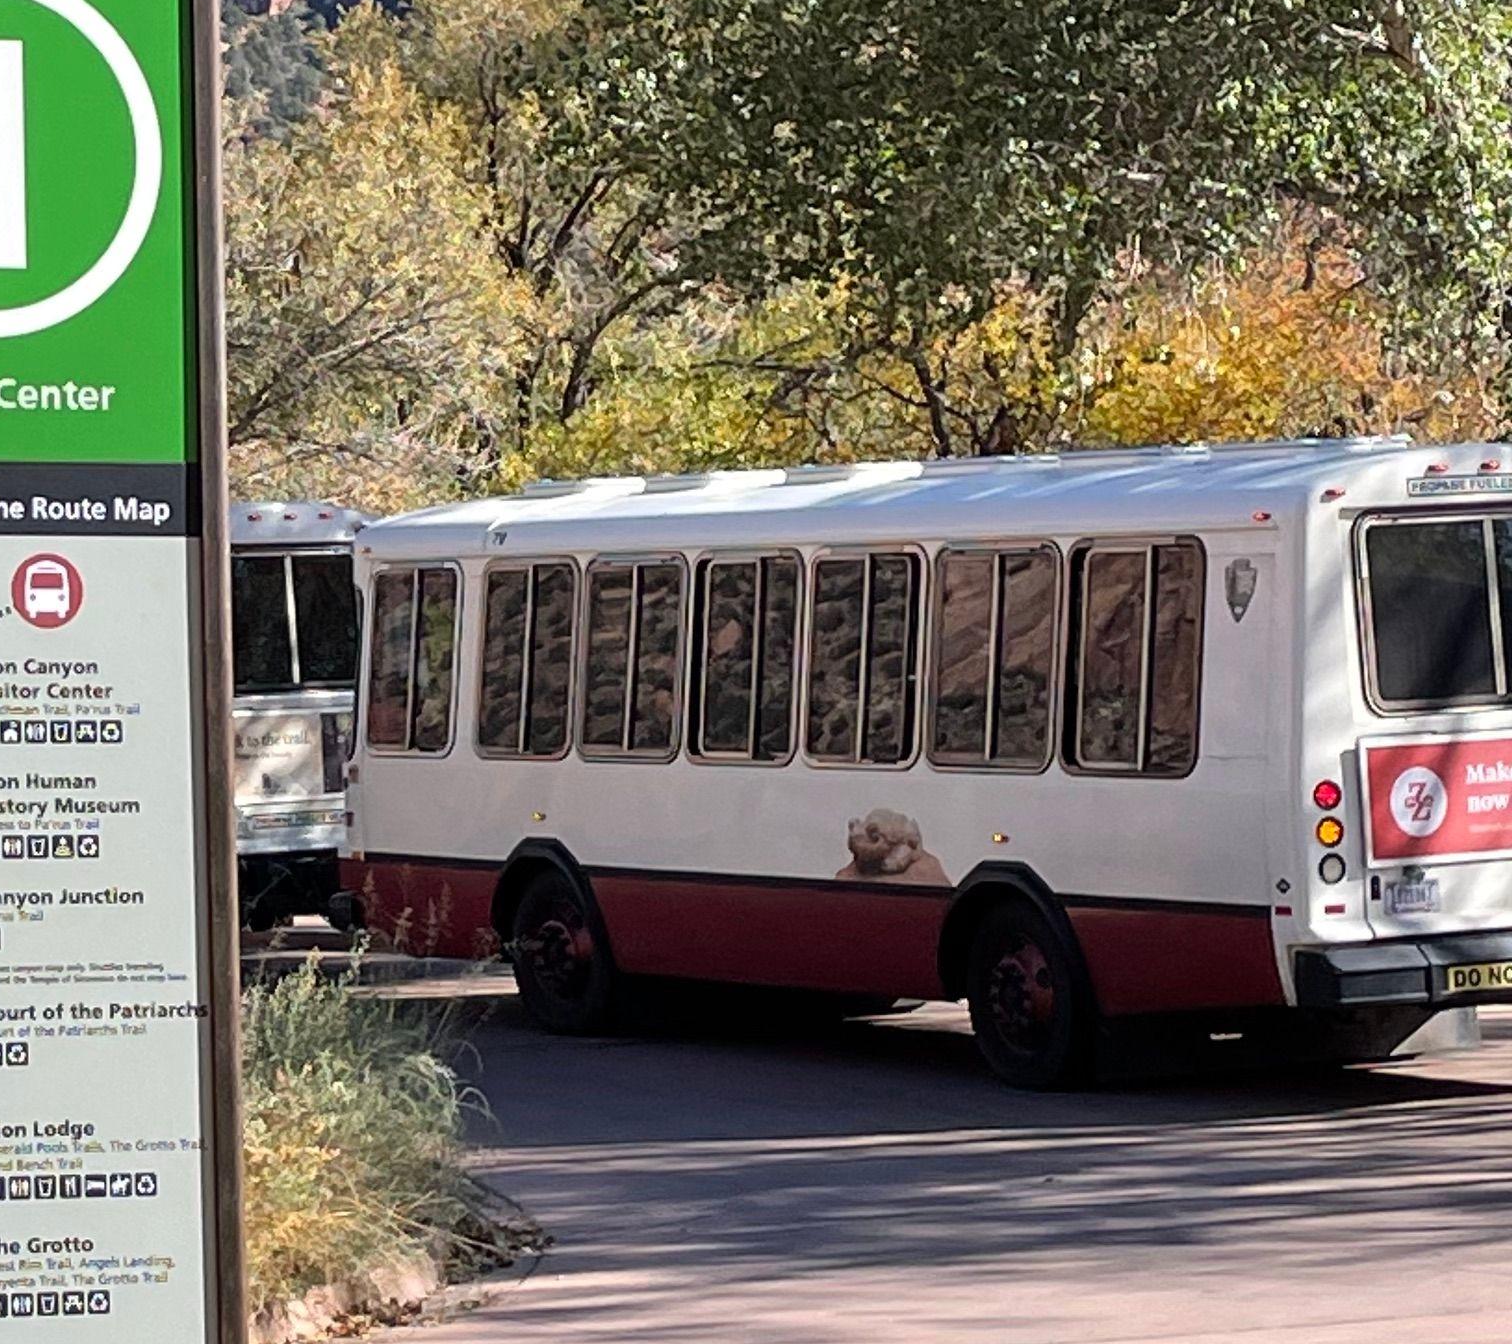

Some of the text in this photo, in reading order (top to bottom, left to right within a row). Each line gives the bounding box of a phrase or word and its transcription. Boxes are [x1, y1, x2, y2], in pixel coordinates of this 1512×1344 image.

[32, 497, 106, 519] Route
[114, 497, 169, 525] Map
[24, 658, 98, 677] Canyon
[47, 683, 112, 698] Center
[26, 773, 96, 788] Human
[55, 797, 139, 813] Museum
[1466, 794, 1509, 813] now
[59, 888, 143, 903] Junction
[1454, 968, 1481, 987] DO
[42, 1003, 63, 1019] of
[70, 1003, 102, 1018] the
[109, 1001, 208, 1018] Patriarchs
[33, 1120, 94, 1141] Lodge
[27, 1237, 93, 1252] Grotto
